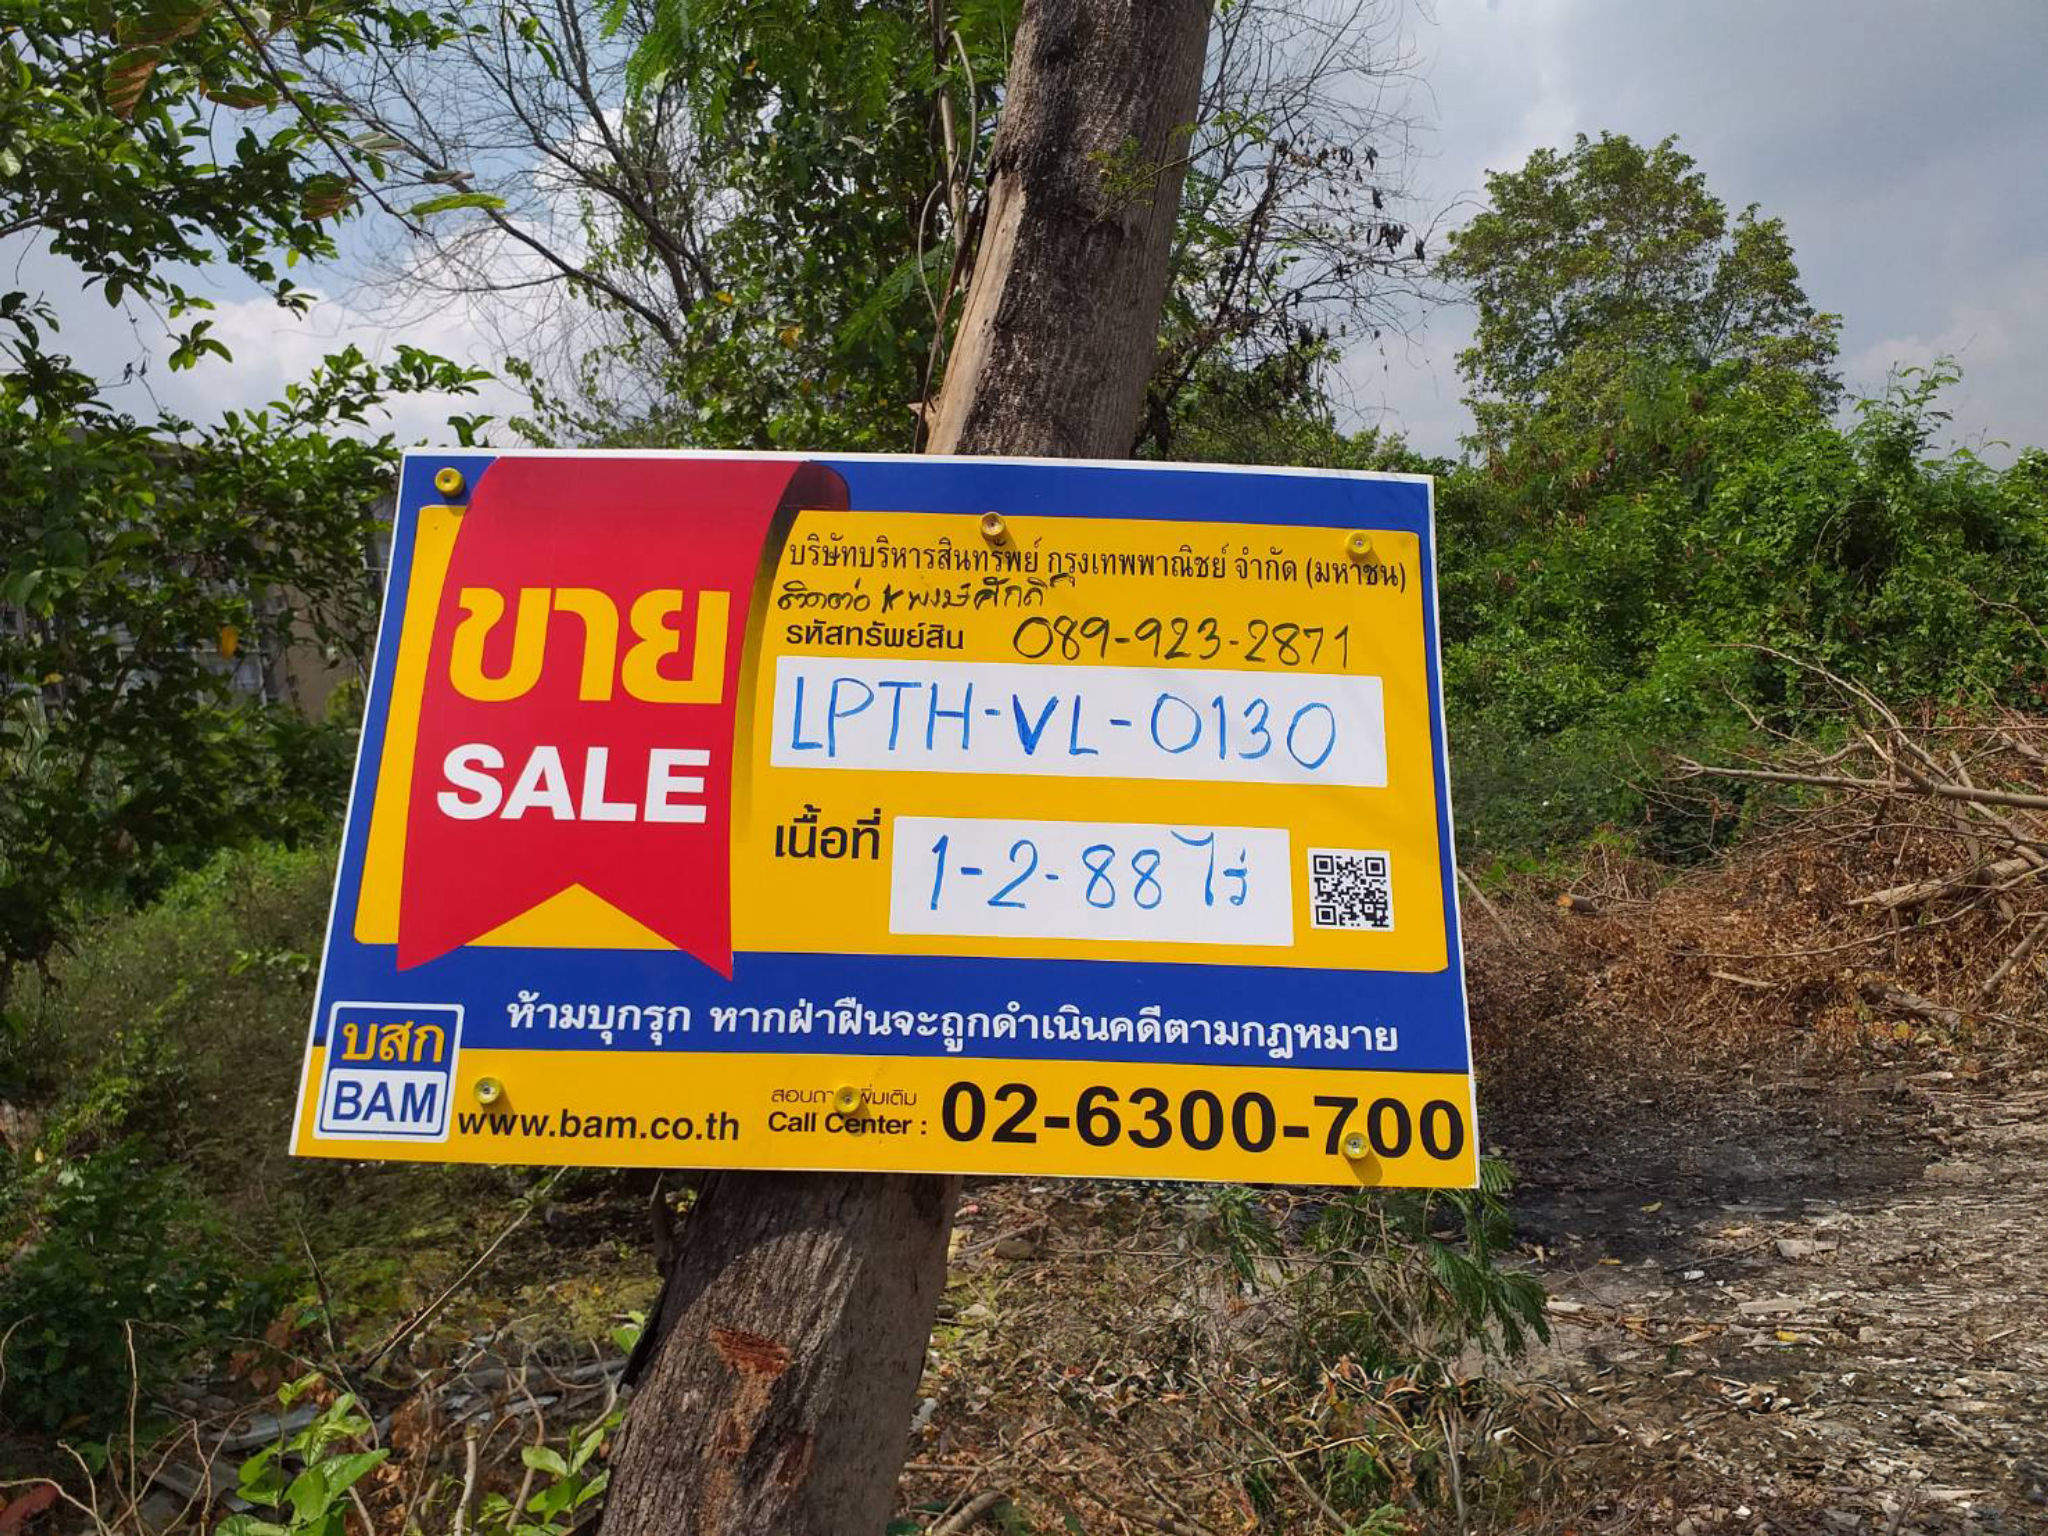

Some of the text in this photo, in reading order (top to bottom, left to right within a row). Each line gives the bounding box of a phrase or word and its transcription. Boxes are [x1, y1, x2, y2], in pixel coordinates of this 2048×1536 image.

[790, 532, 1406, 594] บริษัทบริหารสินทรัพย์ กรุงเทพพาณิชย์ จำกัด (มหาชน)
[450, 587, 731, 704] ขาย
[786, 619, 965, 650] รหัสทรัพย์สิน
[1012, 615, 1350, 669] 089-923-2871
[791, 676, 1337, 770] LPTH-VL-0130
[437, 743, 711, 825] SALE
[774, 803, 882, 861] เนื้อที่
[929, 834, 1163, 911] 1-2-88
[340, 1019, 445, 1065] บสก
[506, 991, 1400, 1060] ห้ามบุกรุก หากฝ่าฝืนจะถูกดำเนินคดีตามกฎหมาย
[332, 1081, 439, 1124] BAM
[458, 1109, 740, 1142] www.bam.co.th
[768, 1111, 818, 1133] Call
[941, 1080, 1465, 1161] 02-6300-700
